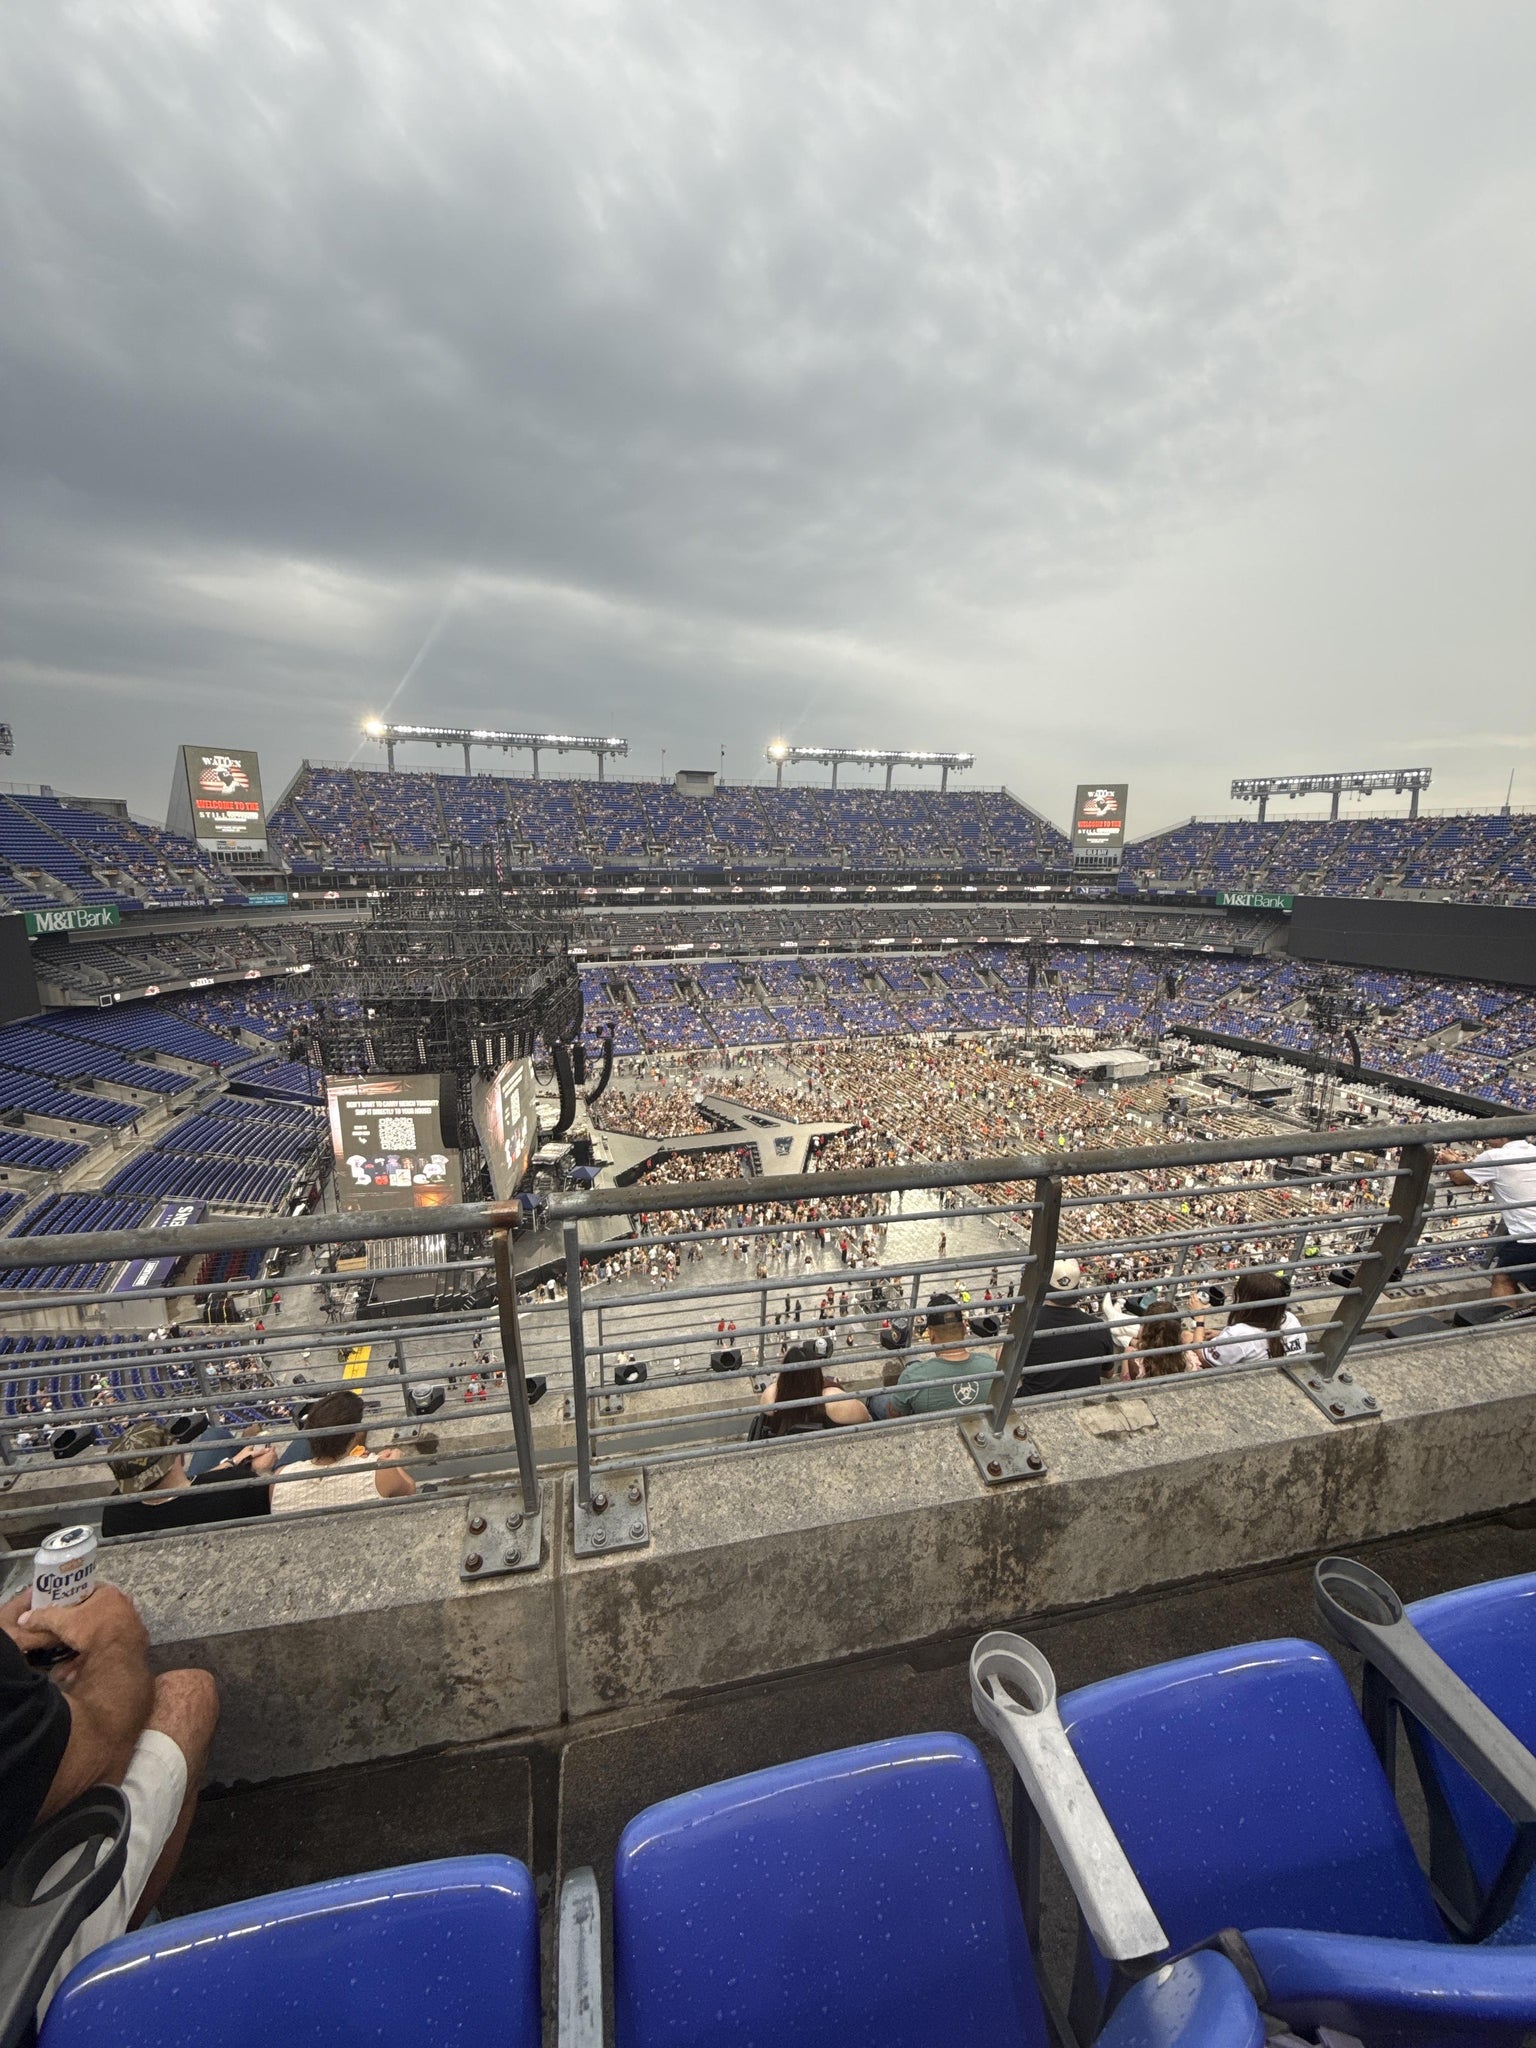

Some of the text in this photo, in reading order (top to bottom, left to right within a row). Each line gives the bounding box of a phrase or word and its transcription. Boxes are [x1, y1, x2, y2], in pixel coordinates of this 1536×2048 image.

[196, 800, 259, 811] WELCOME TO THE
[1222, 893, 1284, 908] M&T Bank
[34, 908, 113, 932] M&T Bank
[169, 1206, 194, 1227] ENS
[51, 1581, 88, 1601] Extra
